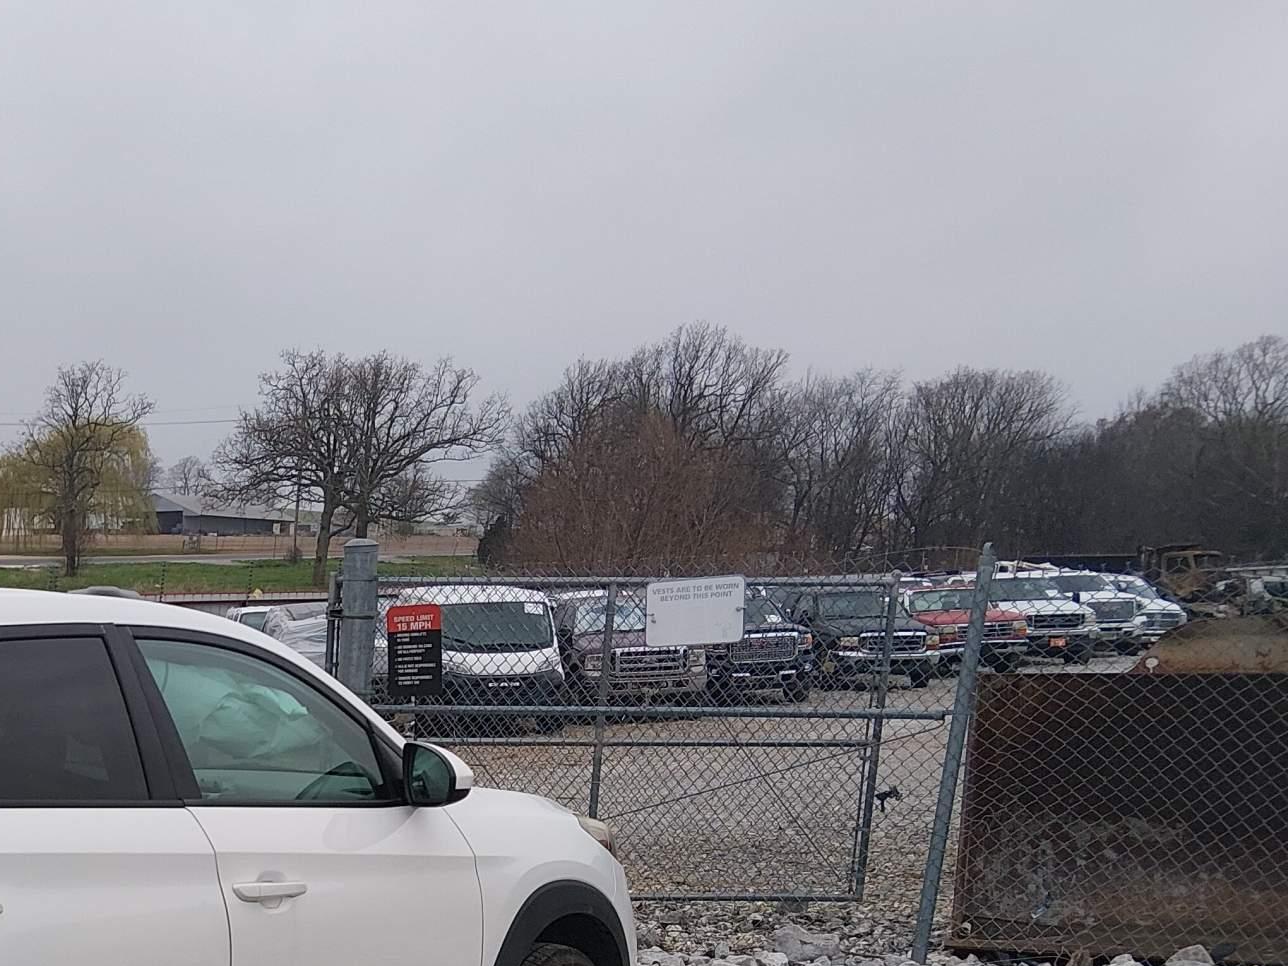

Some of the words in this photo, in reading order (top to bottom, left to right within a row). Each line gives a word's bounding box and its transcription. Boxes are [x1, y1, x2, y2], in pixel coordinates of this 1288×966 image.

[652, 587, 674, 595] VESTS
[693, 592, 709, 600] THIS
[710, 591, 733, 599] POINT
[396, 622, 408, 631] 15
[410, 621, 432, 630] MPH
